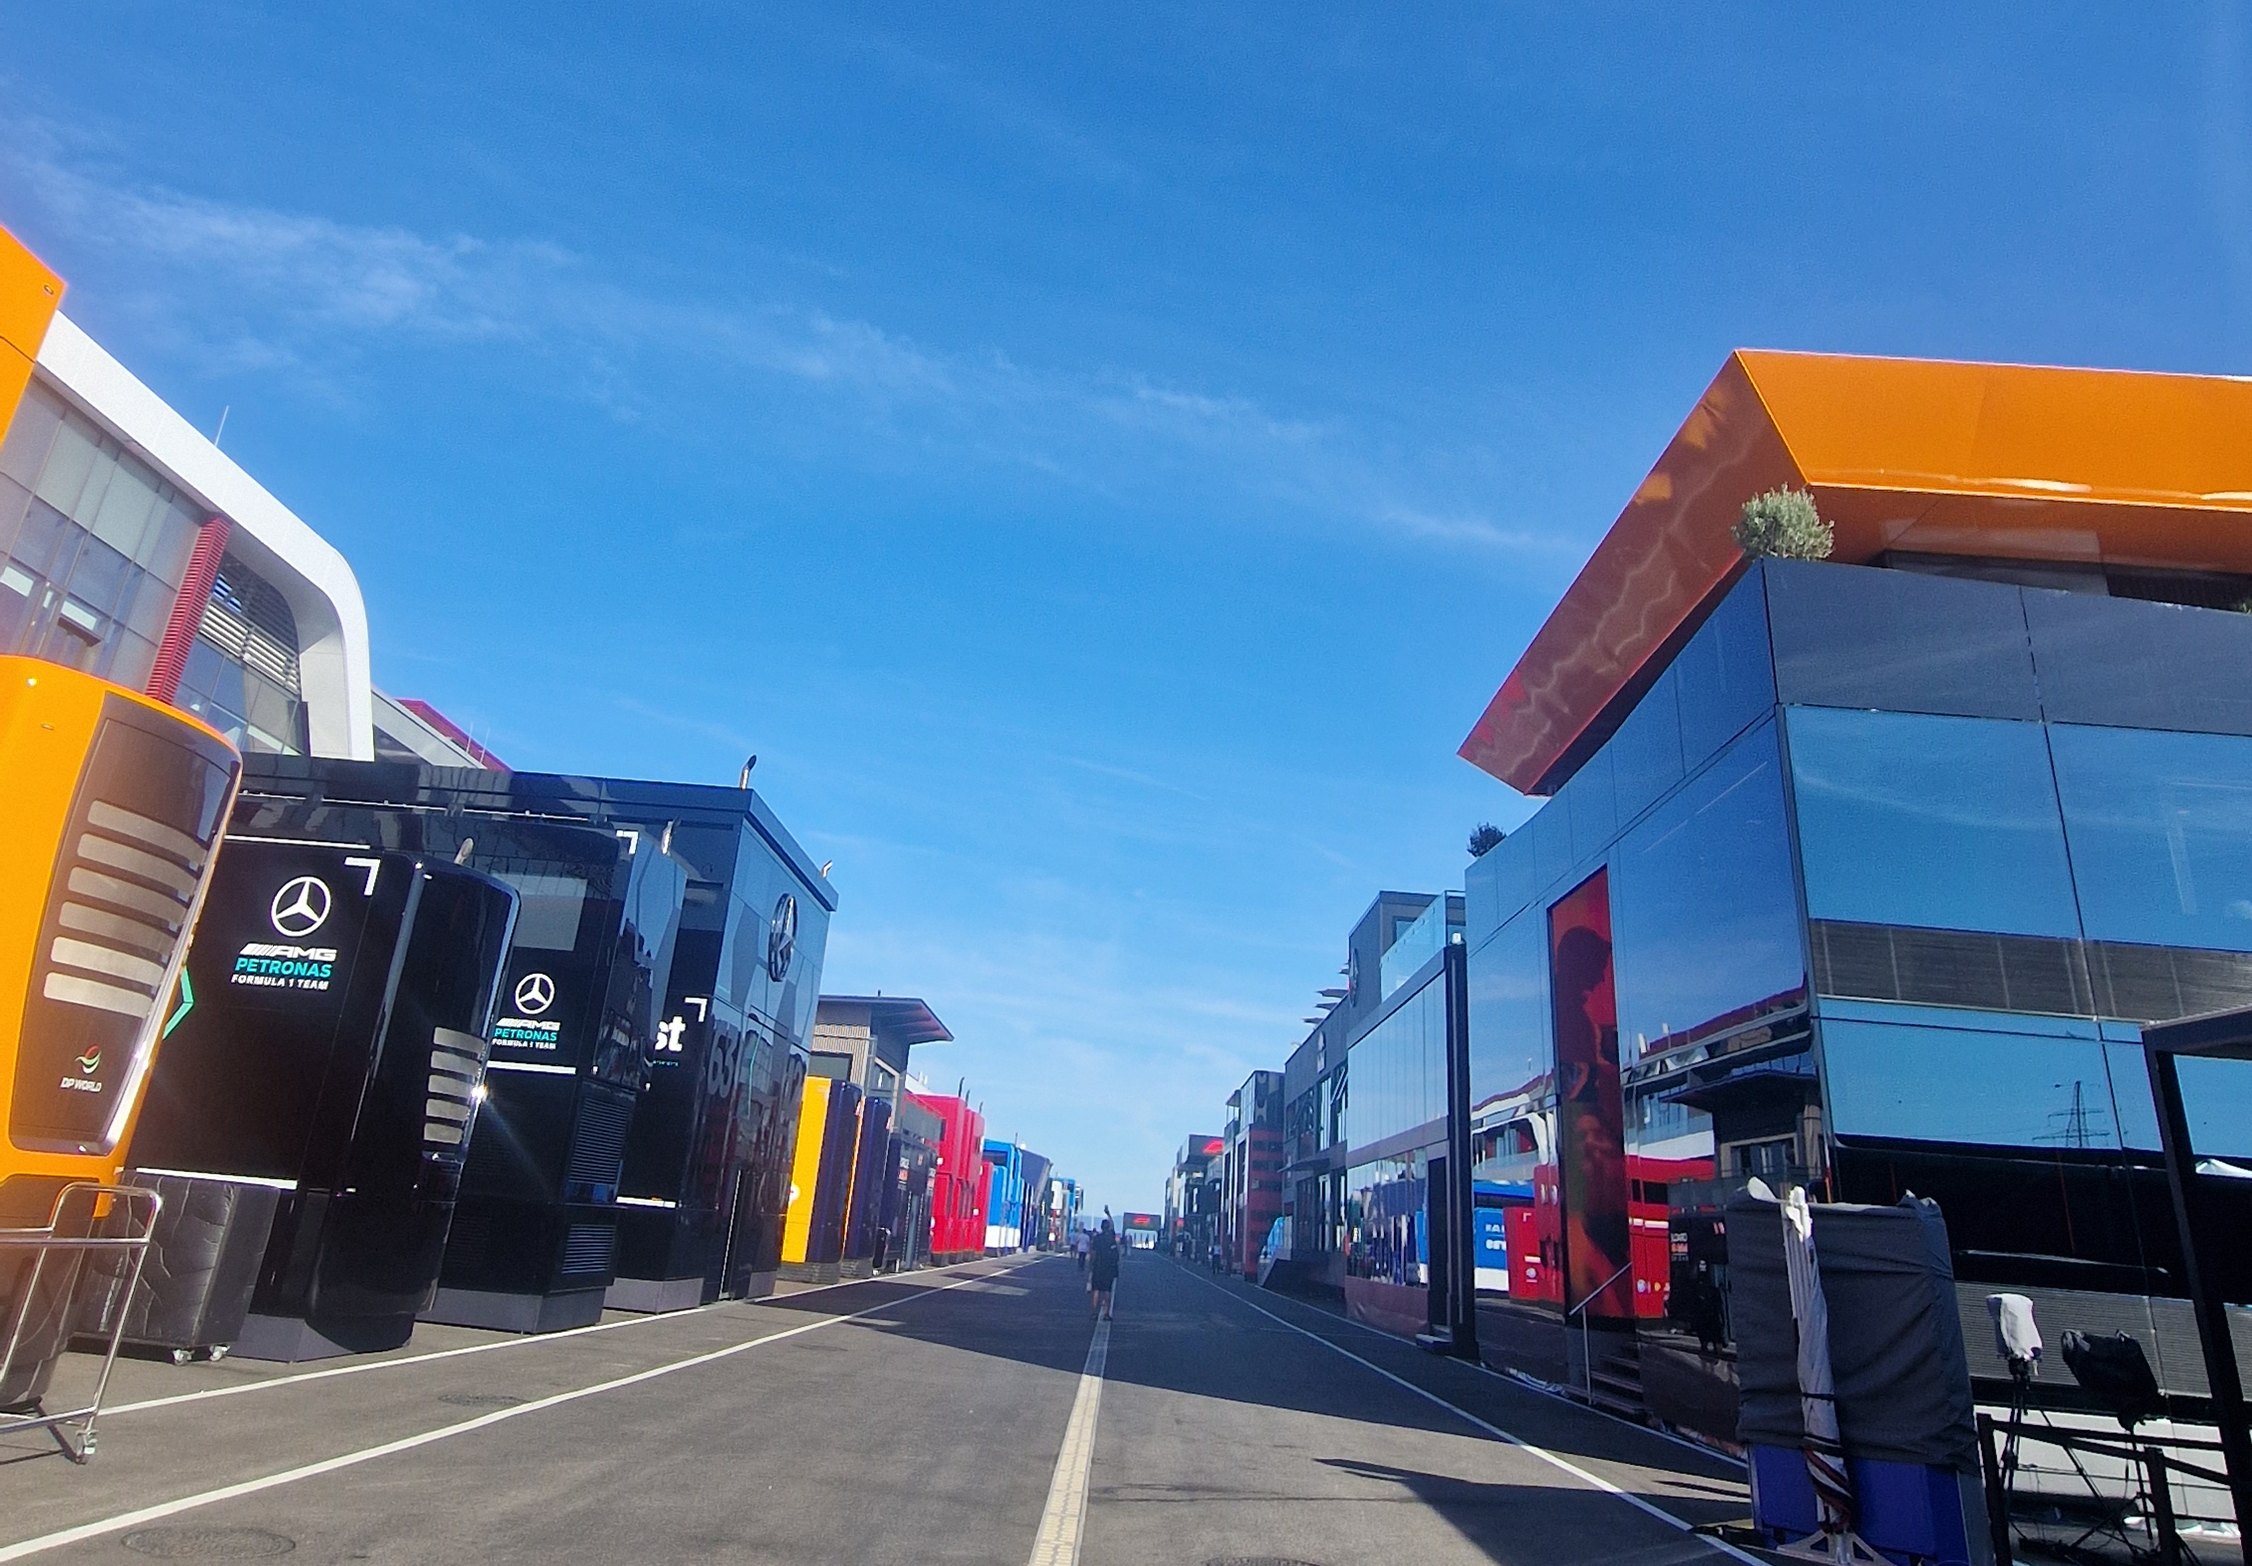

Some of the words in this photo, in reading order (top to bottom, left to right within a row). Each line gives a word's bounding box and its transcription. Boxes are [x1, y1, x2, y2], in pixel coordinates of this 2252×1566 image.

[262, 944, 337, 961] AMG
[235, 958, 332, 978] PETRONAS
[230, 974, 285, 987] FORMULA
[288, 978, 295, 988] 1
[297, 979, 329, 990] TEAM
[494, 1028, 557, 1041] PETRONAS
[60, 1077, 75, 1089] DP
[74, 1079, 102, 1092] WORLD
